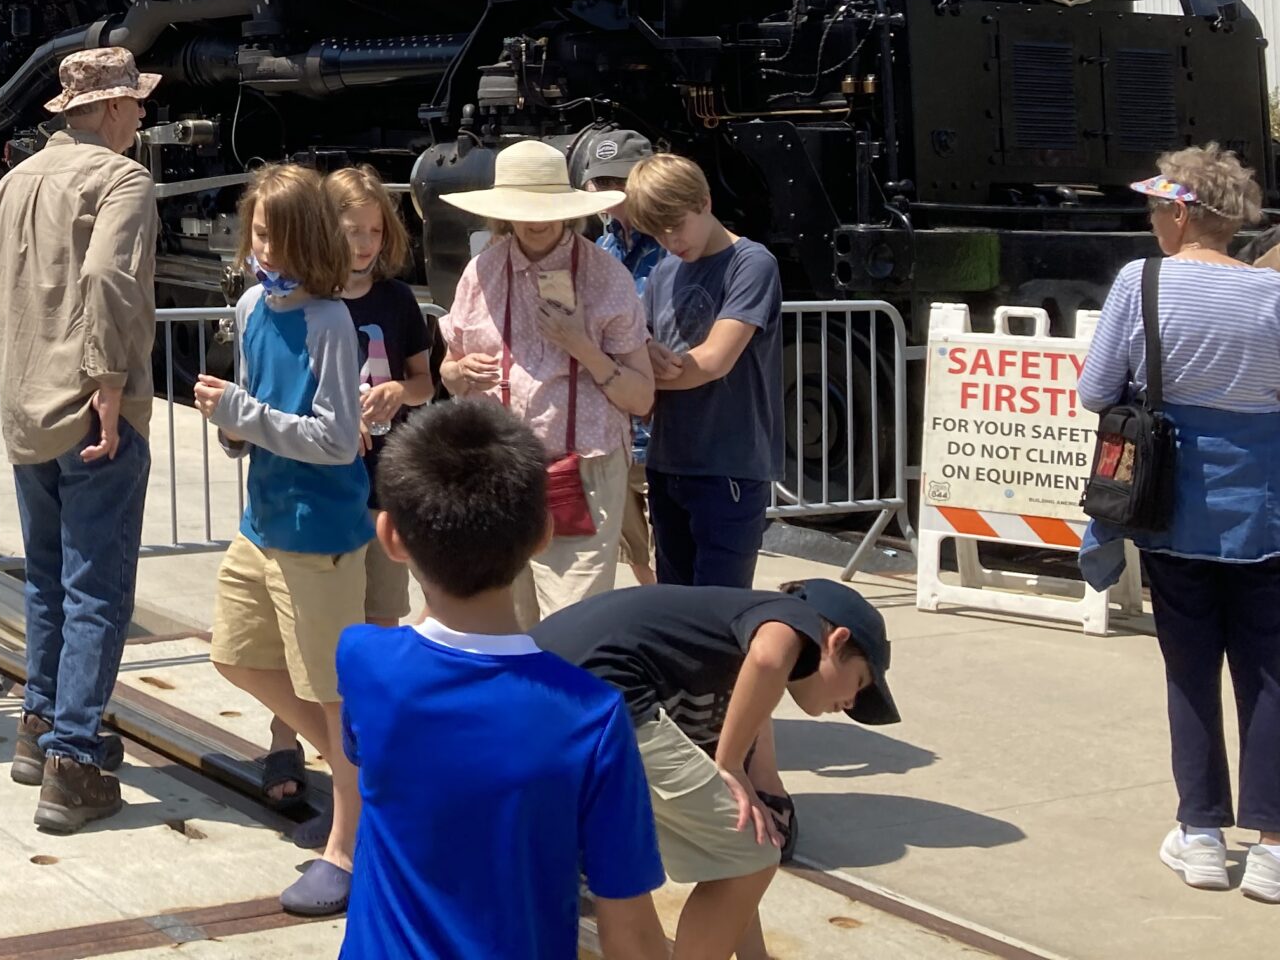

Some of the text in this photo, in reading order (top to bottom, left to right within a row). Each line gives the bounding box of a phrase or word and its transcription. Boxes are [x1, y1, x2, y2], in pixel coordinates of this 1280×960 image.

[960, 382, 1077, 418] FIRST!
[932, 417, 969, 433] FOR
[973, 420, 1026, 438] YOUR
[947, 441, 1087, 467] DO NOT CLIMB
[942, 464, 1090, 491] ON EQUIPMENT
